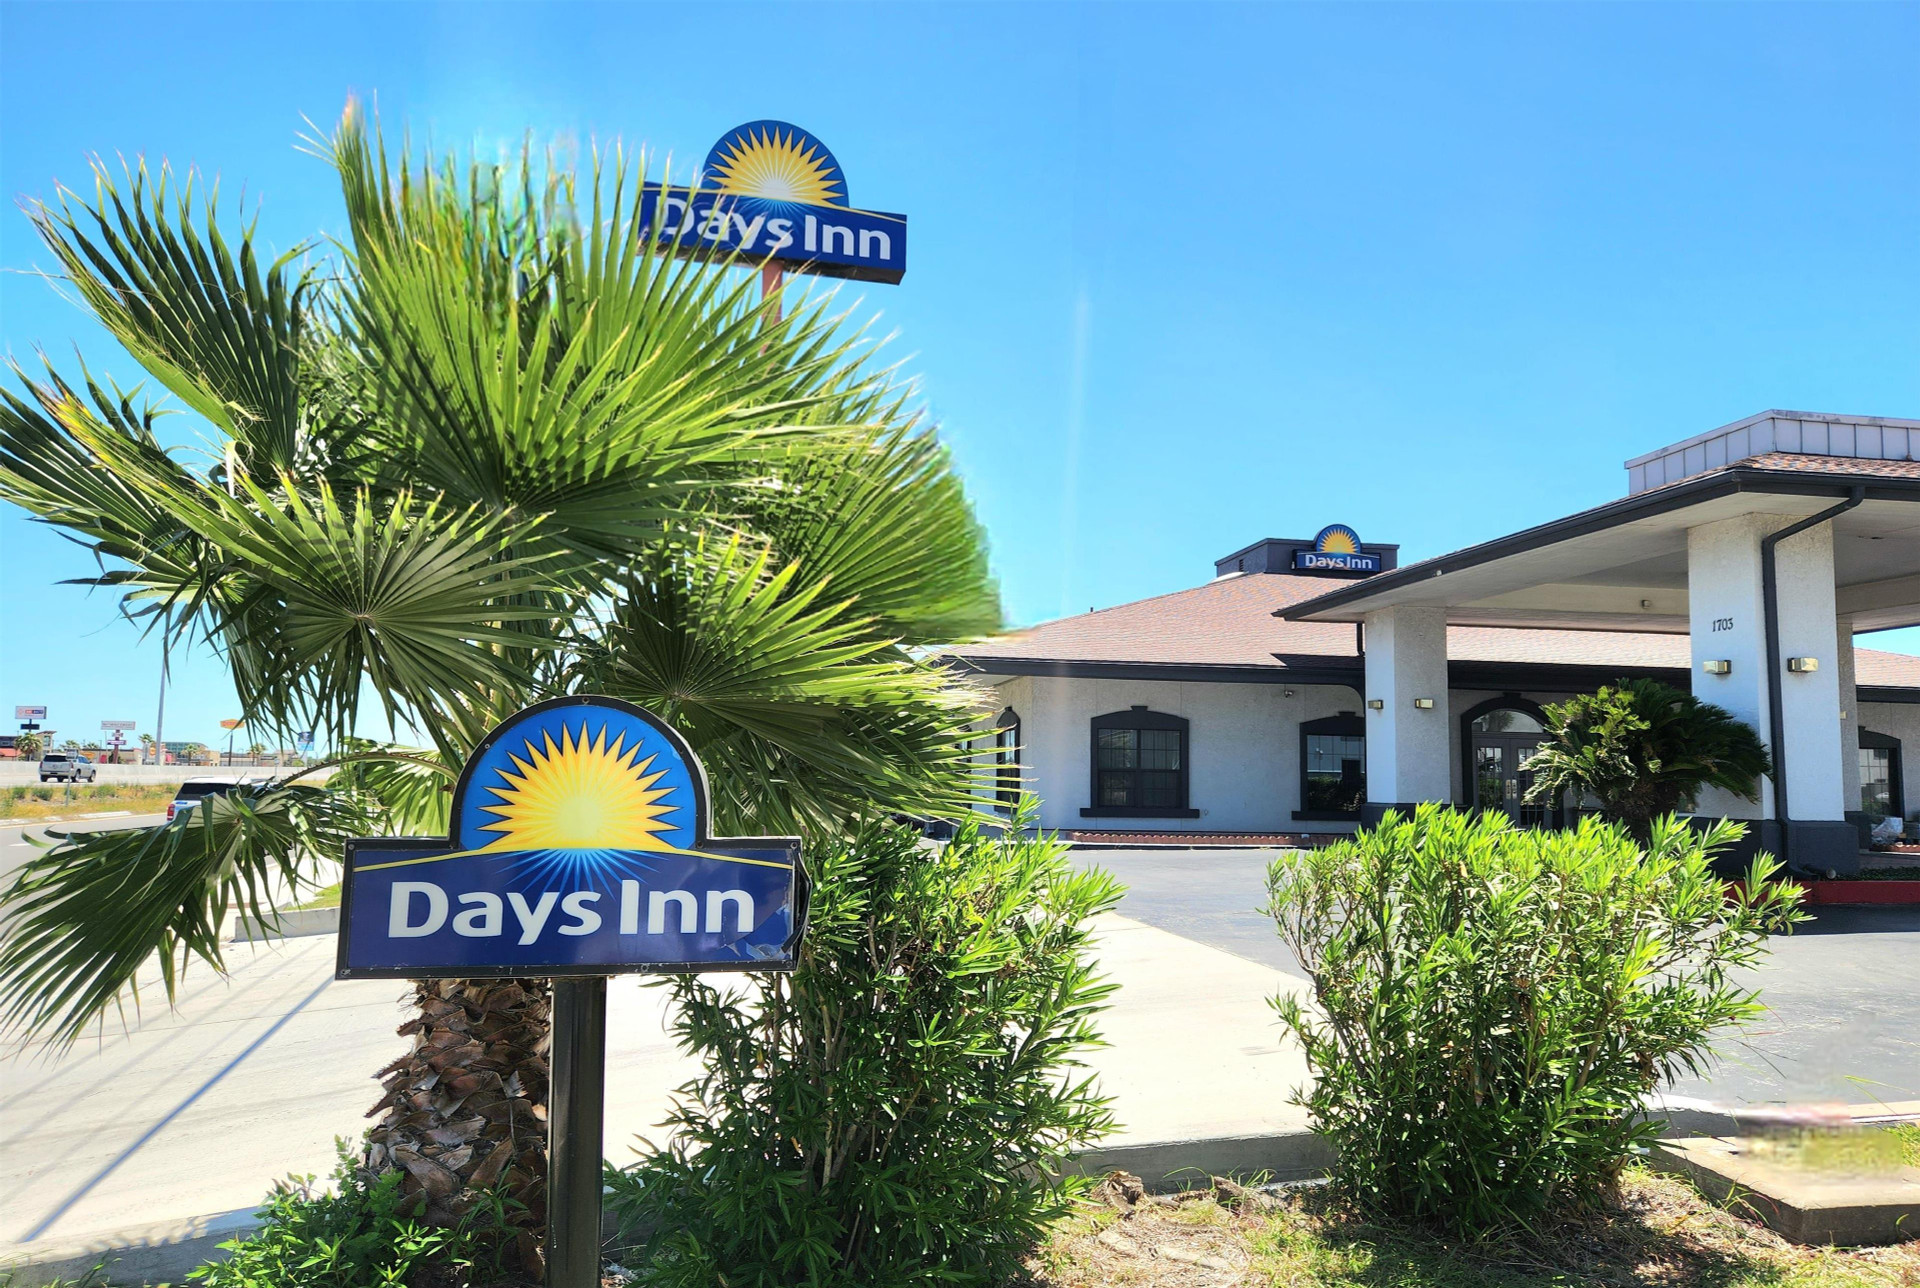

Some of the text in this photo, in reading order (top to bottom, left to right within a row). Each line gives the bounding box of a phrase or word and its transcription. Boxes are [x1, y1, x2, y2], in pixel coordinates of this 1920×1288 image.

[655, 196, 891, 260] Days Inn
[1305, 554, 1372, 569] Days Inn
[1712, 617, 1734, 632] 1703
[388, 879, 755, 945] Days Inn
